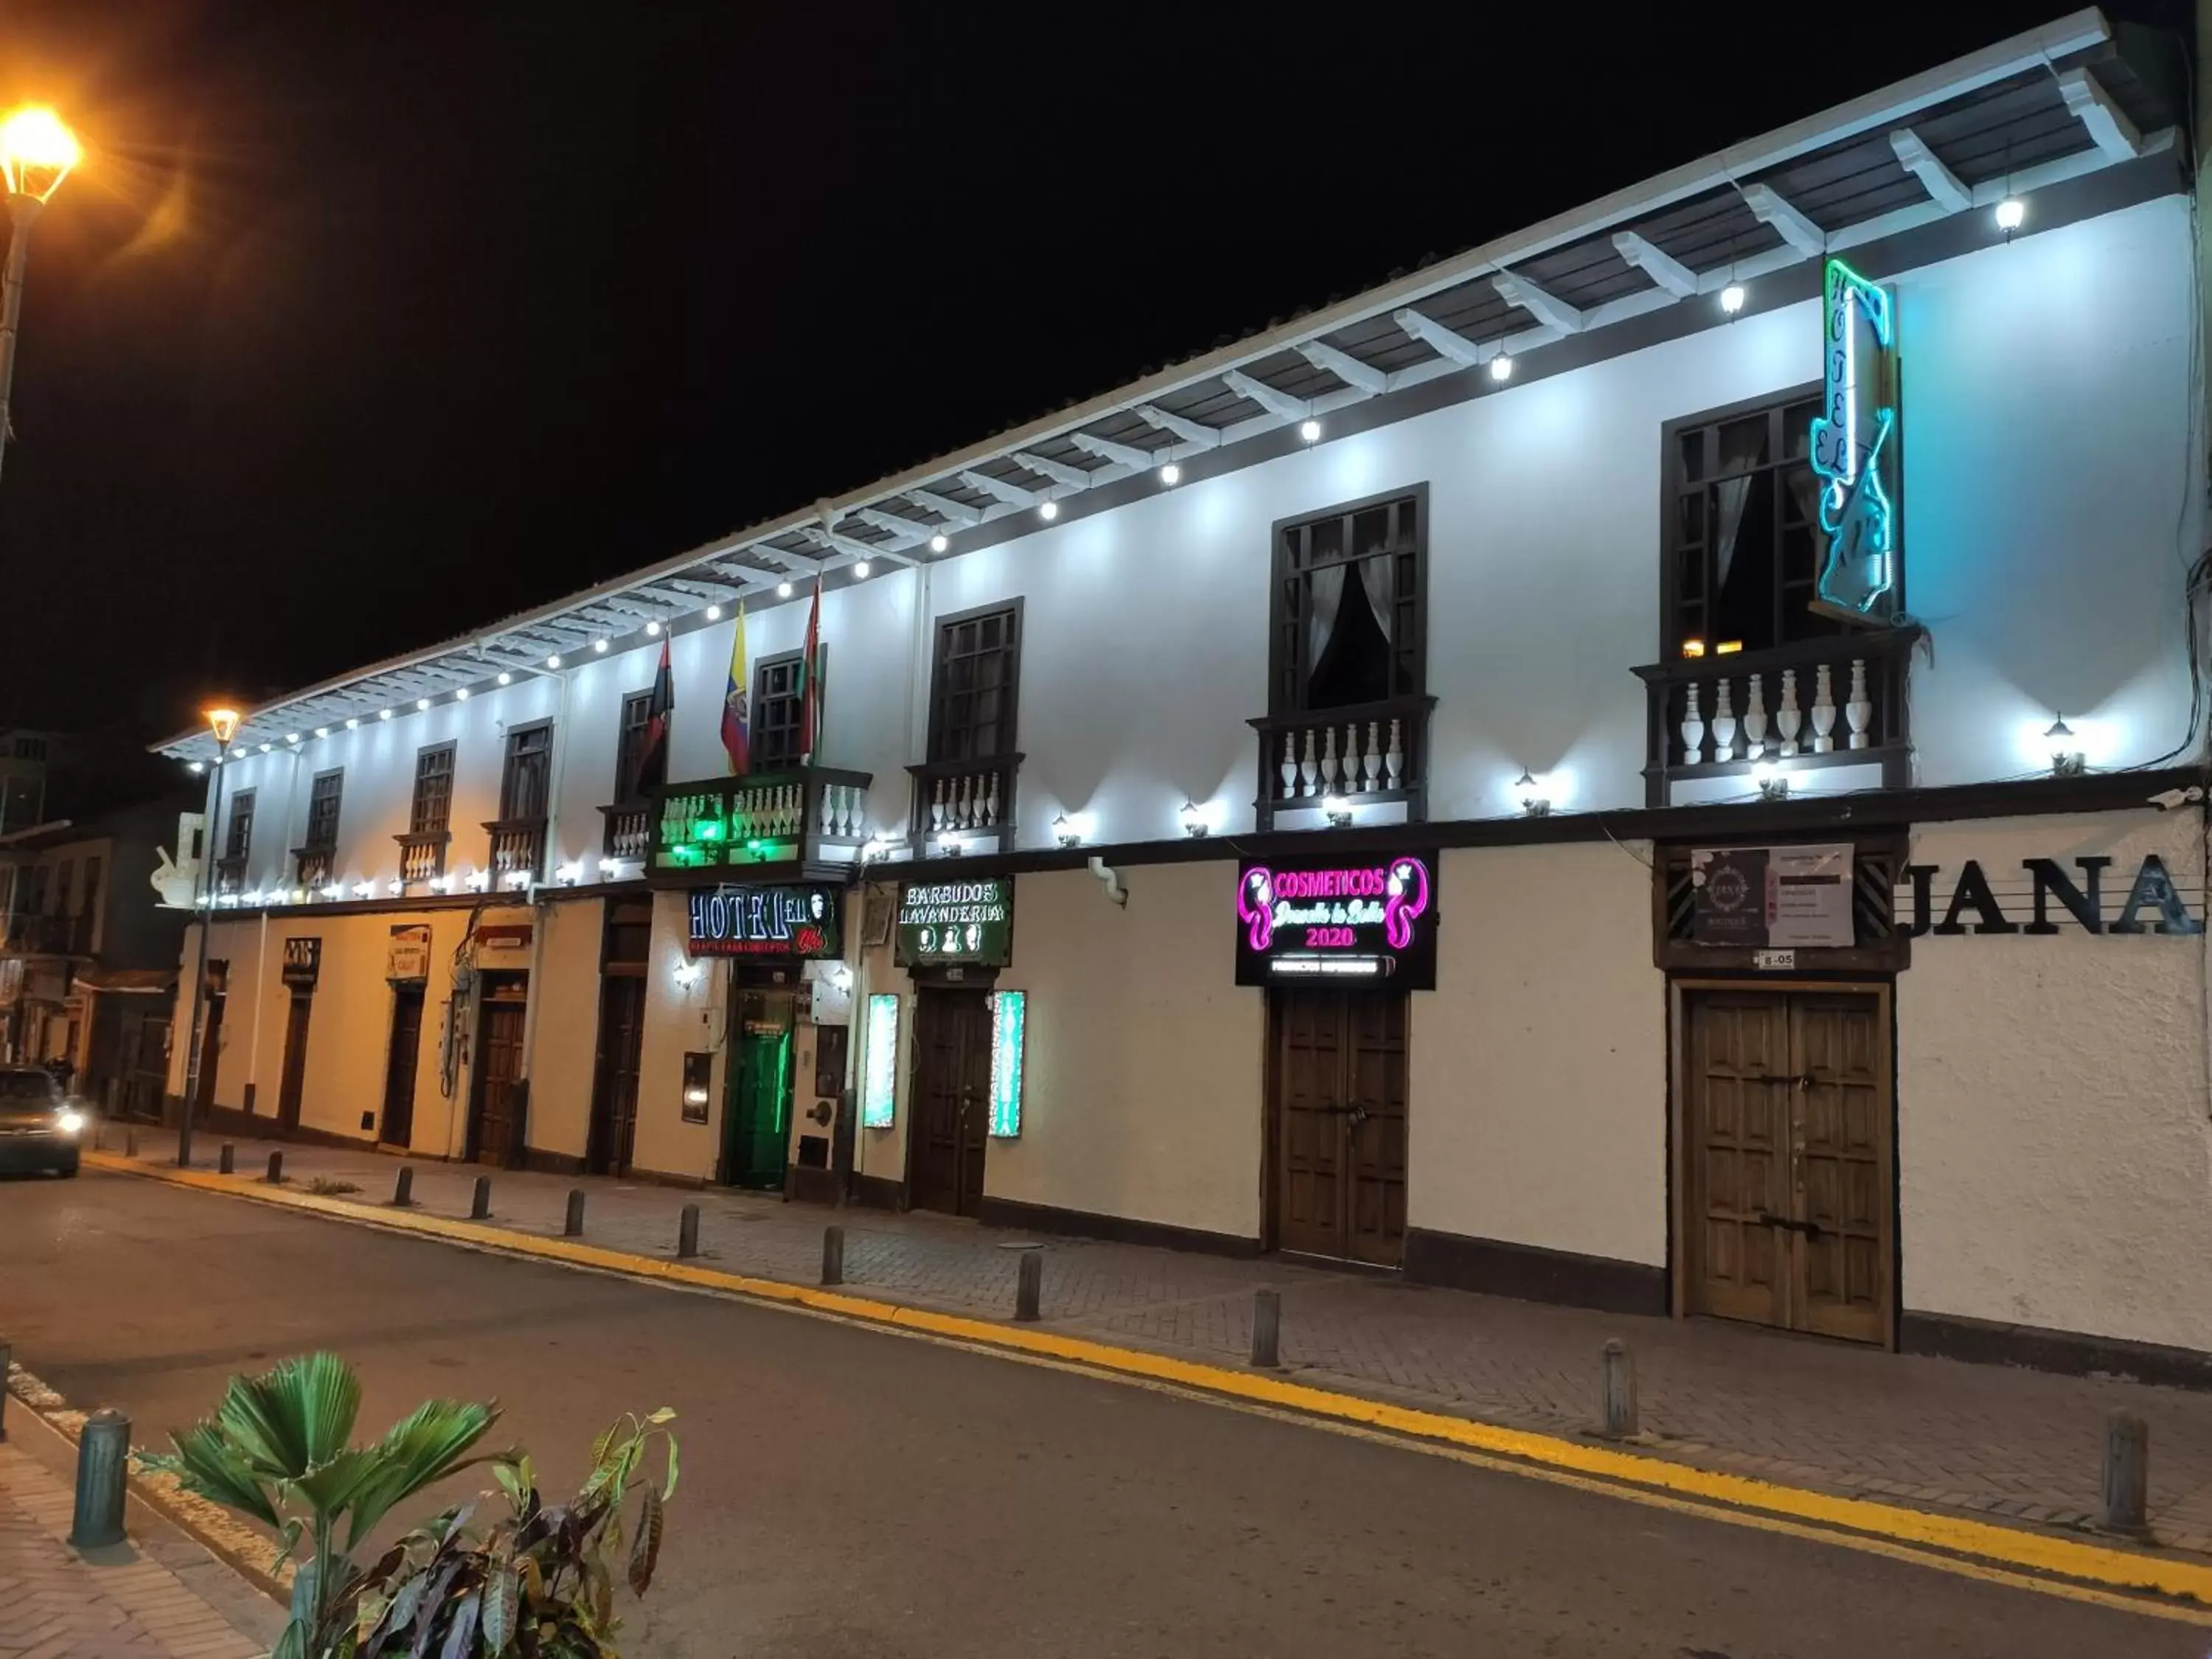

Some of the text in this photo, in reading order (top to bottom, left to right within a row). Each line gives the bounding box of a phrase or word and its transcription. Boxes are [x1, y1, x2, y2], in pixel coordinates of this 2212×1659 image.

[906, 883, 998, 905] BARBUDOS
[1274, 869, 1384, 897] COSMETICOS
[1894, 854, 2204, 938] JANA
[690, 892, 789, 939] HOTEL
[899, 905, 1004, 924] LAVANDERIA
[1305, 928, 1355, 947] 2020
